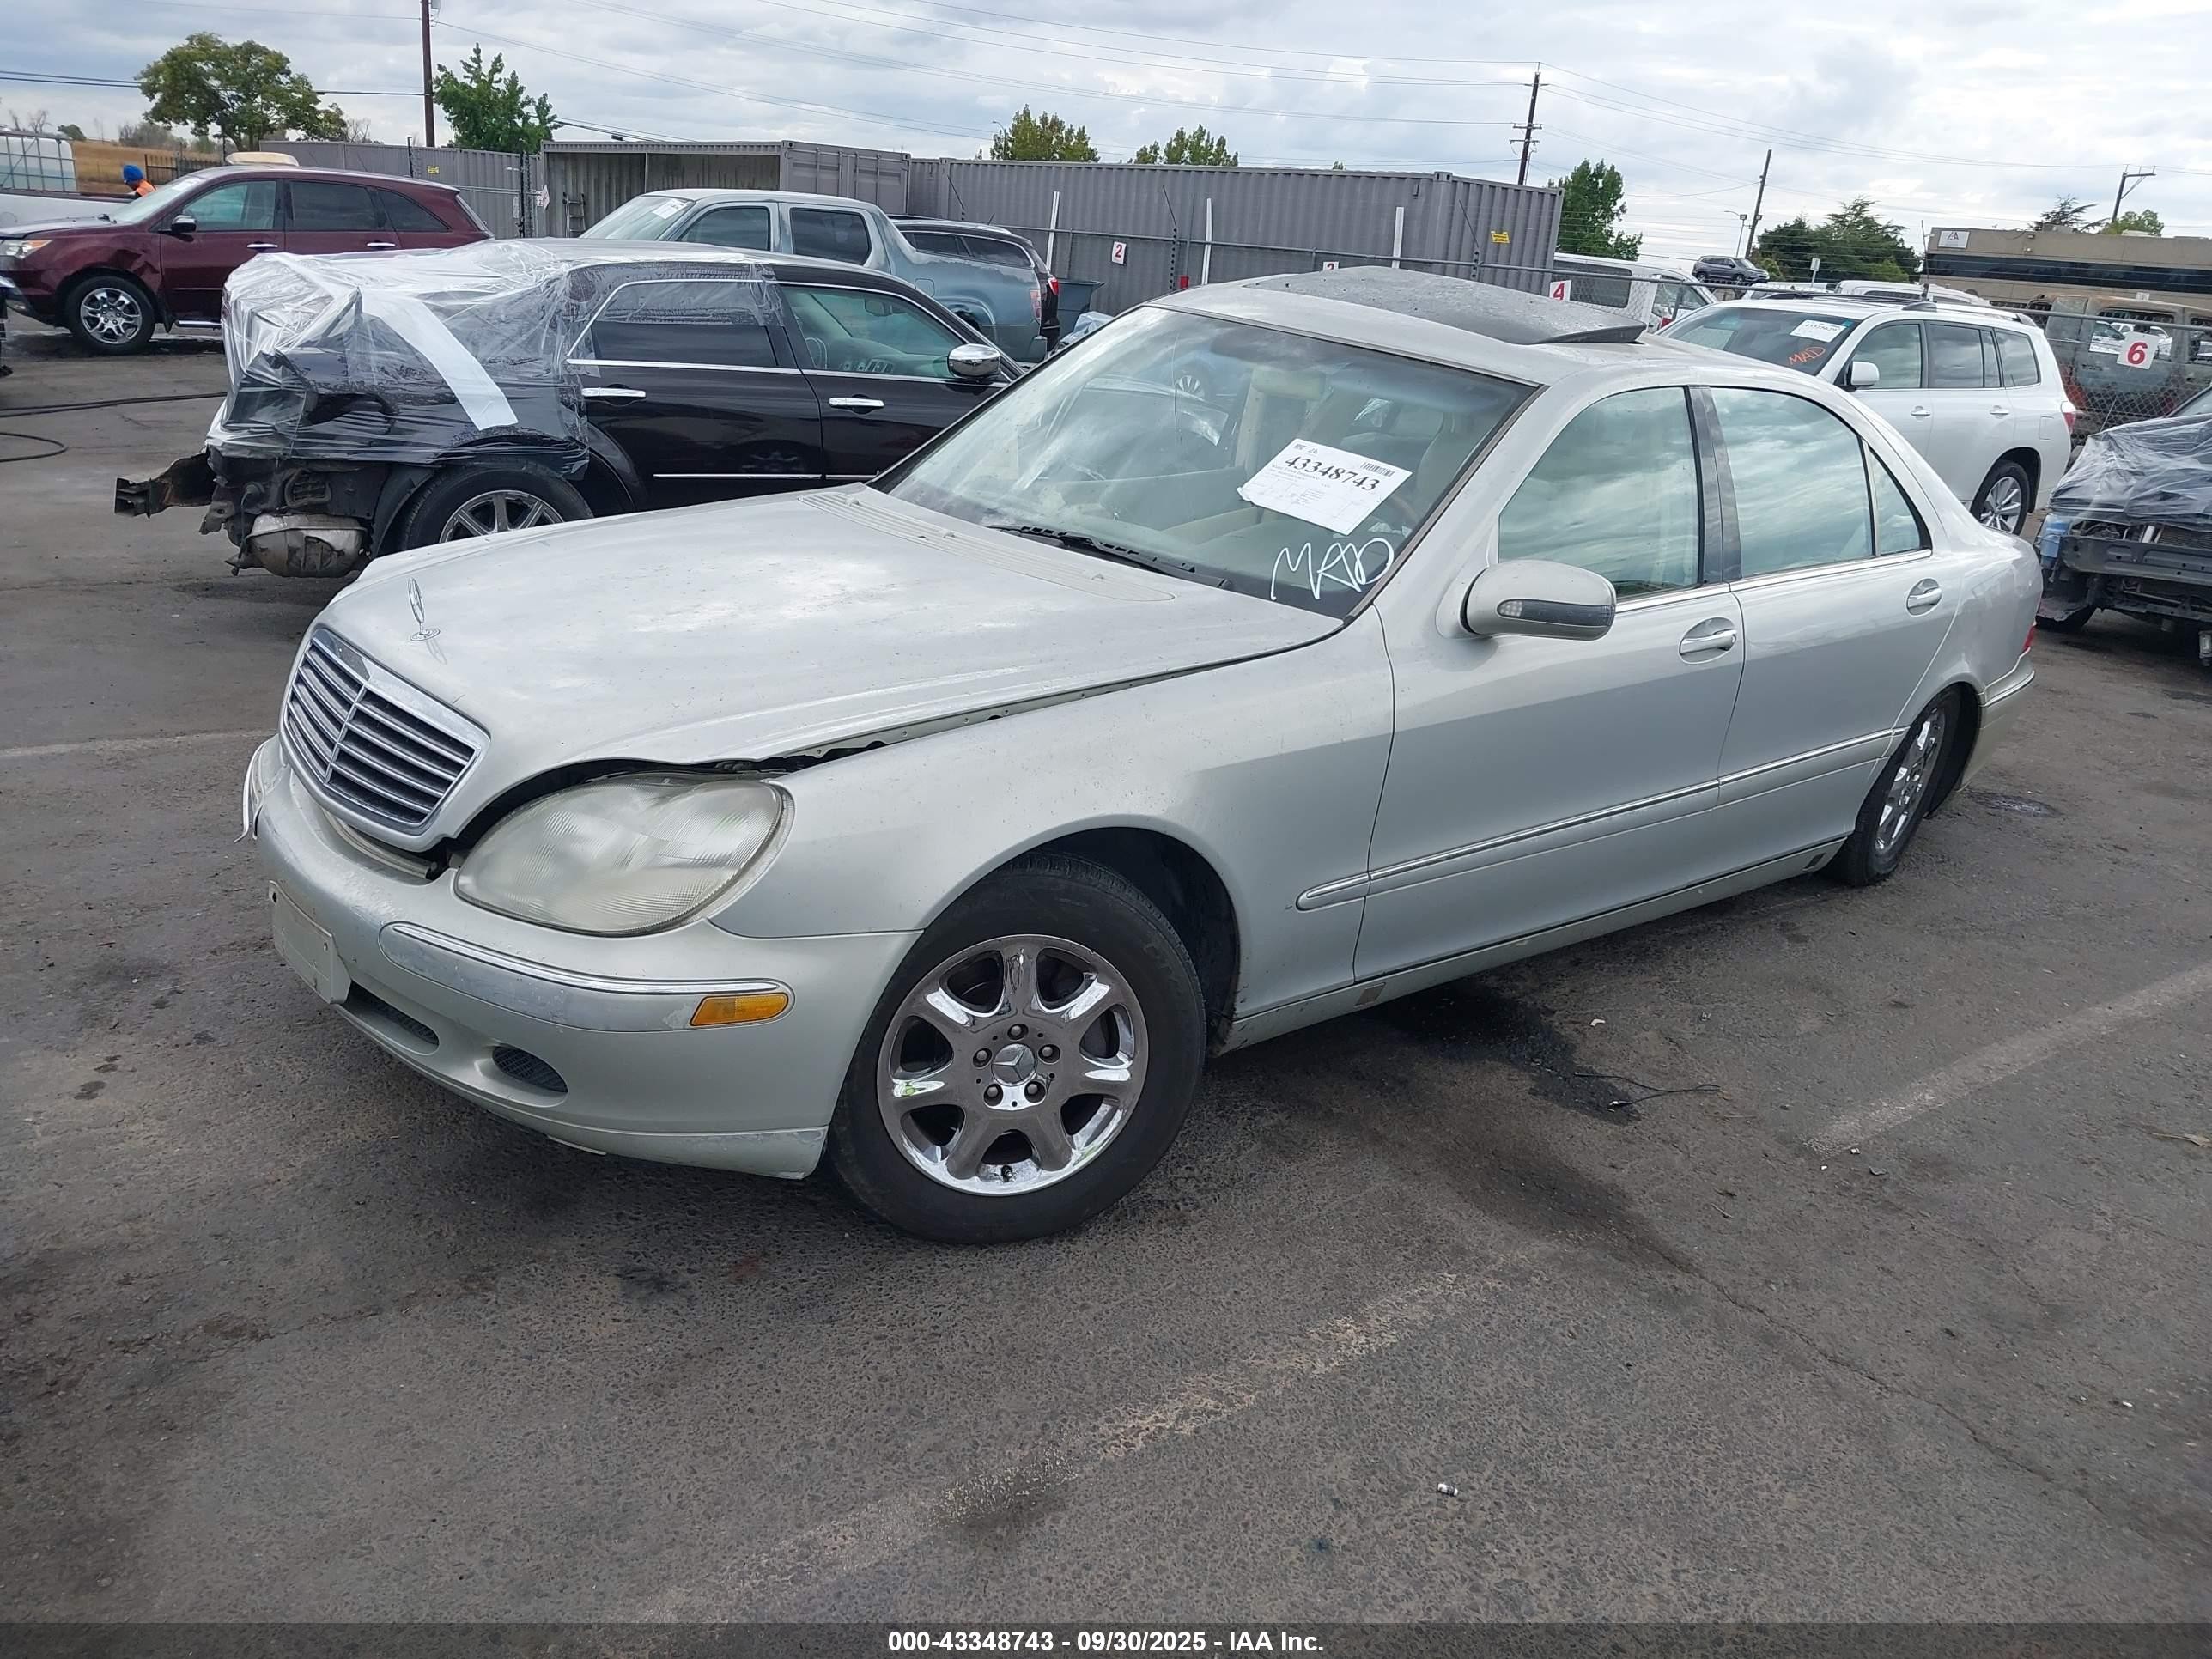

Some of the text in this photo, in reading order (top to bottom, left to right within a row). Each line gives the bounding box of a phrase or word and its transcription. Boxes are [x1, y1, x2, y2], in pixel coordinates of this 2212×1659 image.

[1115, 244, 1123, 258] 2
[1553, 283, 1565, 301] 4
[1789, 346, 1826, 365] MAD
[2127, 342, 2148, 365] 6
[1285, 456, 1381, 491] 43348743
[1270, 538, 1395, 601] MAD
